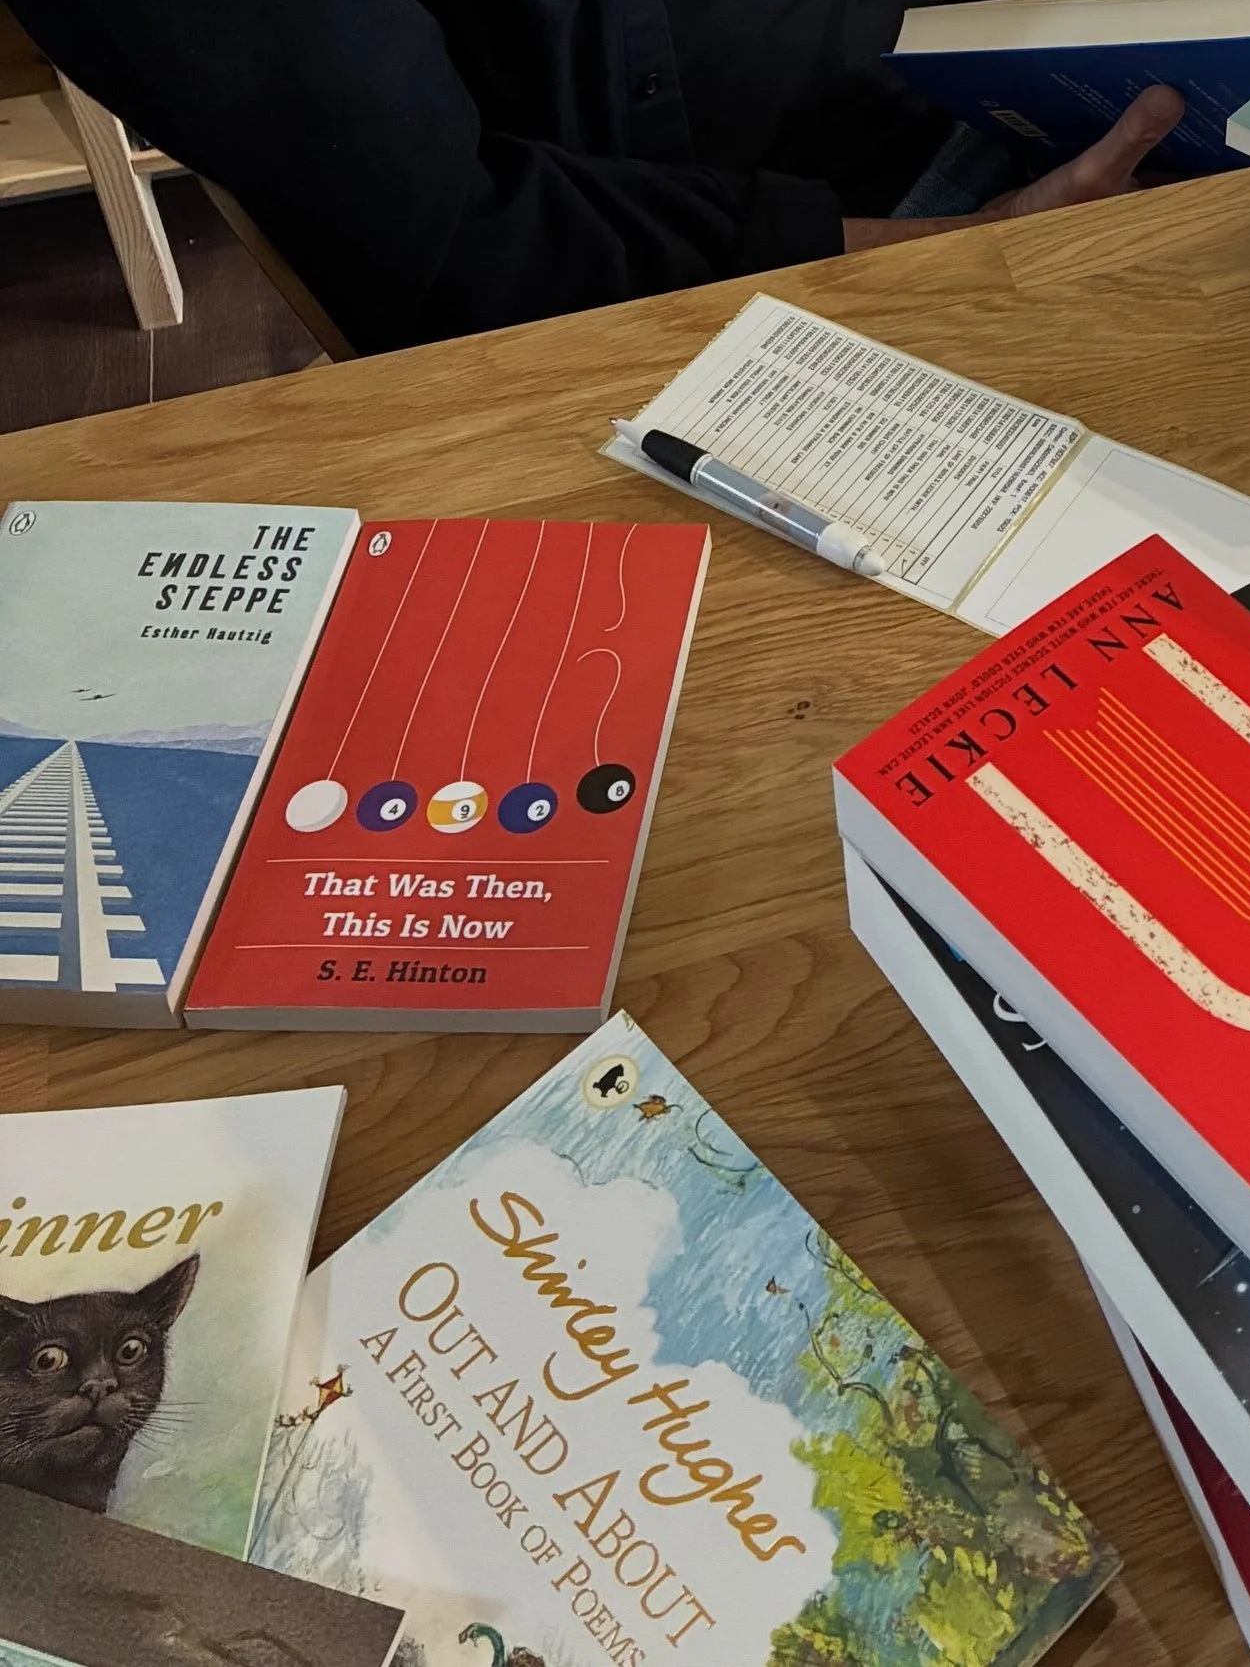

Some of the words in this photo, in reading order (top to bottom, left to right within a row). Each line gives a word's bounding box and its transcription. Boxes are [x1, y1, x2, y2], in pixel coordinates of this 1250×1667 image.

[251, 525, 317, 552] THE
[137, 552, 304, 582] ENDLESS
[154, 585, 292, 615] STEPPE
[140, 624, 201, 642] Esther
[205, 627, 274, 646] Hautzig
[1086, 580, 1185, 664] ANN
[894, 663, 1079, 808] LECKIE
[615, 784, 625, 798] 8
[388, 803, 400, 818] 4
[459, 803, 471, 820] 9
[534, 804, 547, 818] 2
[303, 872, 379, 898] That
[388, 873, 456, 899] Was
[465, 875, 554, 904] Then,
[321, 913, 393, 939] This
[400, 914, 431, 940] Is
[437, 915, 515, 941] Now
[316, 961, 343, 984] S.
[351, 961, 377, 984] E.
[385, 961, 489, 986] Hinton
[468, 1190, 640, 1402] Shirley
[626, 1378, 808, 1563] Hughes
[359, 1326, 399, 1365] A
[385, 1348, 463, 1443] FIRST
[450, 1430, 530, 1530] BOOK
[520, 1524, 564, 1566] OF
[398, 1261, 499, 1380] OUT
[472, 1378, 570, 1476] AND
[552, 1469, 717, 1649] ABOUT
